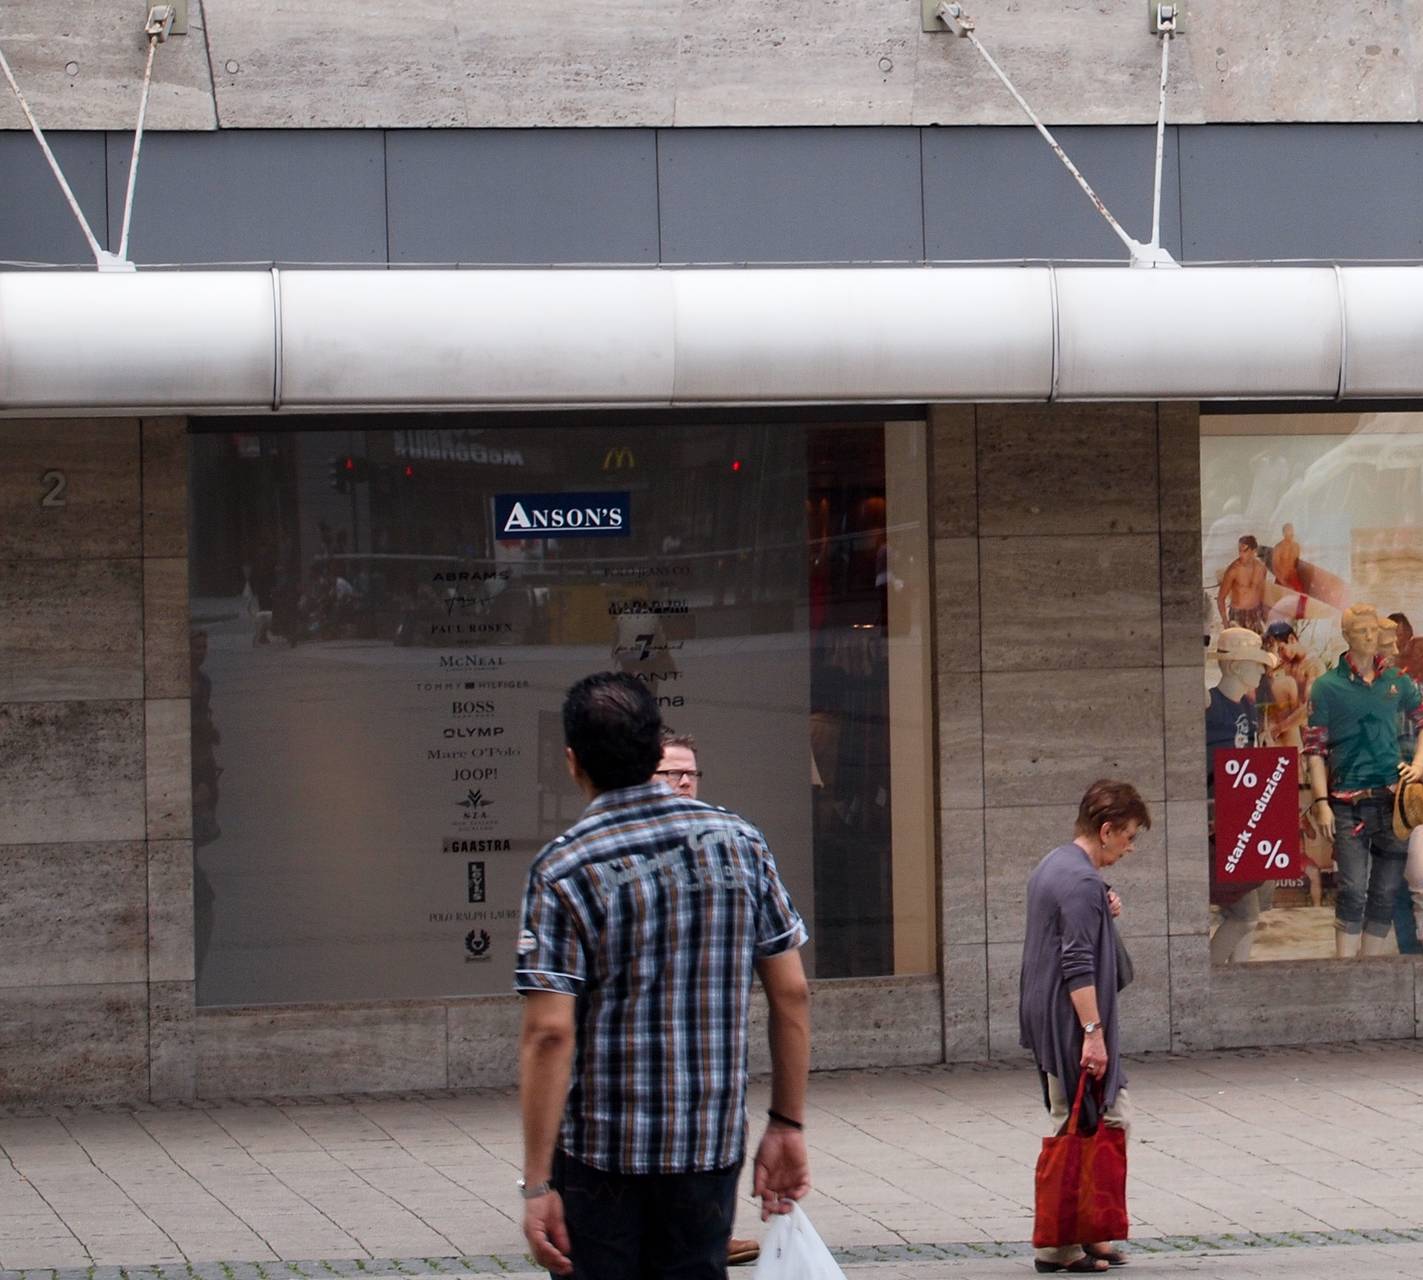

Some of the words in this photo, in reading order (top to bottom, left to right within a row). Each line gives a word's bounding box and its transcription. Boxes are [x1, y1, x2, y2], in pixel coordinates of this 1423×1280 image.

[43, 470, 66, 507] 2
[504, 501, 622, 532] ANSON'S
[479, 681, 529, 689] HILFIGER
[452, 700, 495, 714] BOSS
[443, 727, 504, 738] OLYMP
[452, 767, 498, 781] JOOP!
[1225, 829, 1252, 874] stark
[1248, 756, 1290, 829] reduziert
[452, 839, 511, 853] GAASTRA
